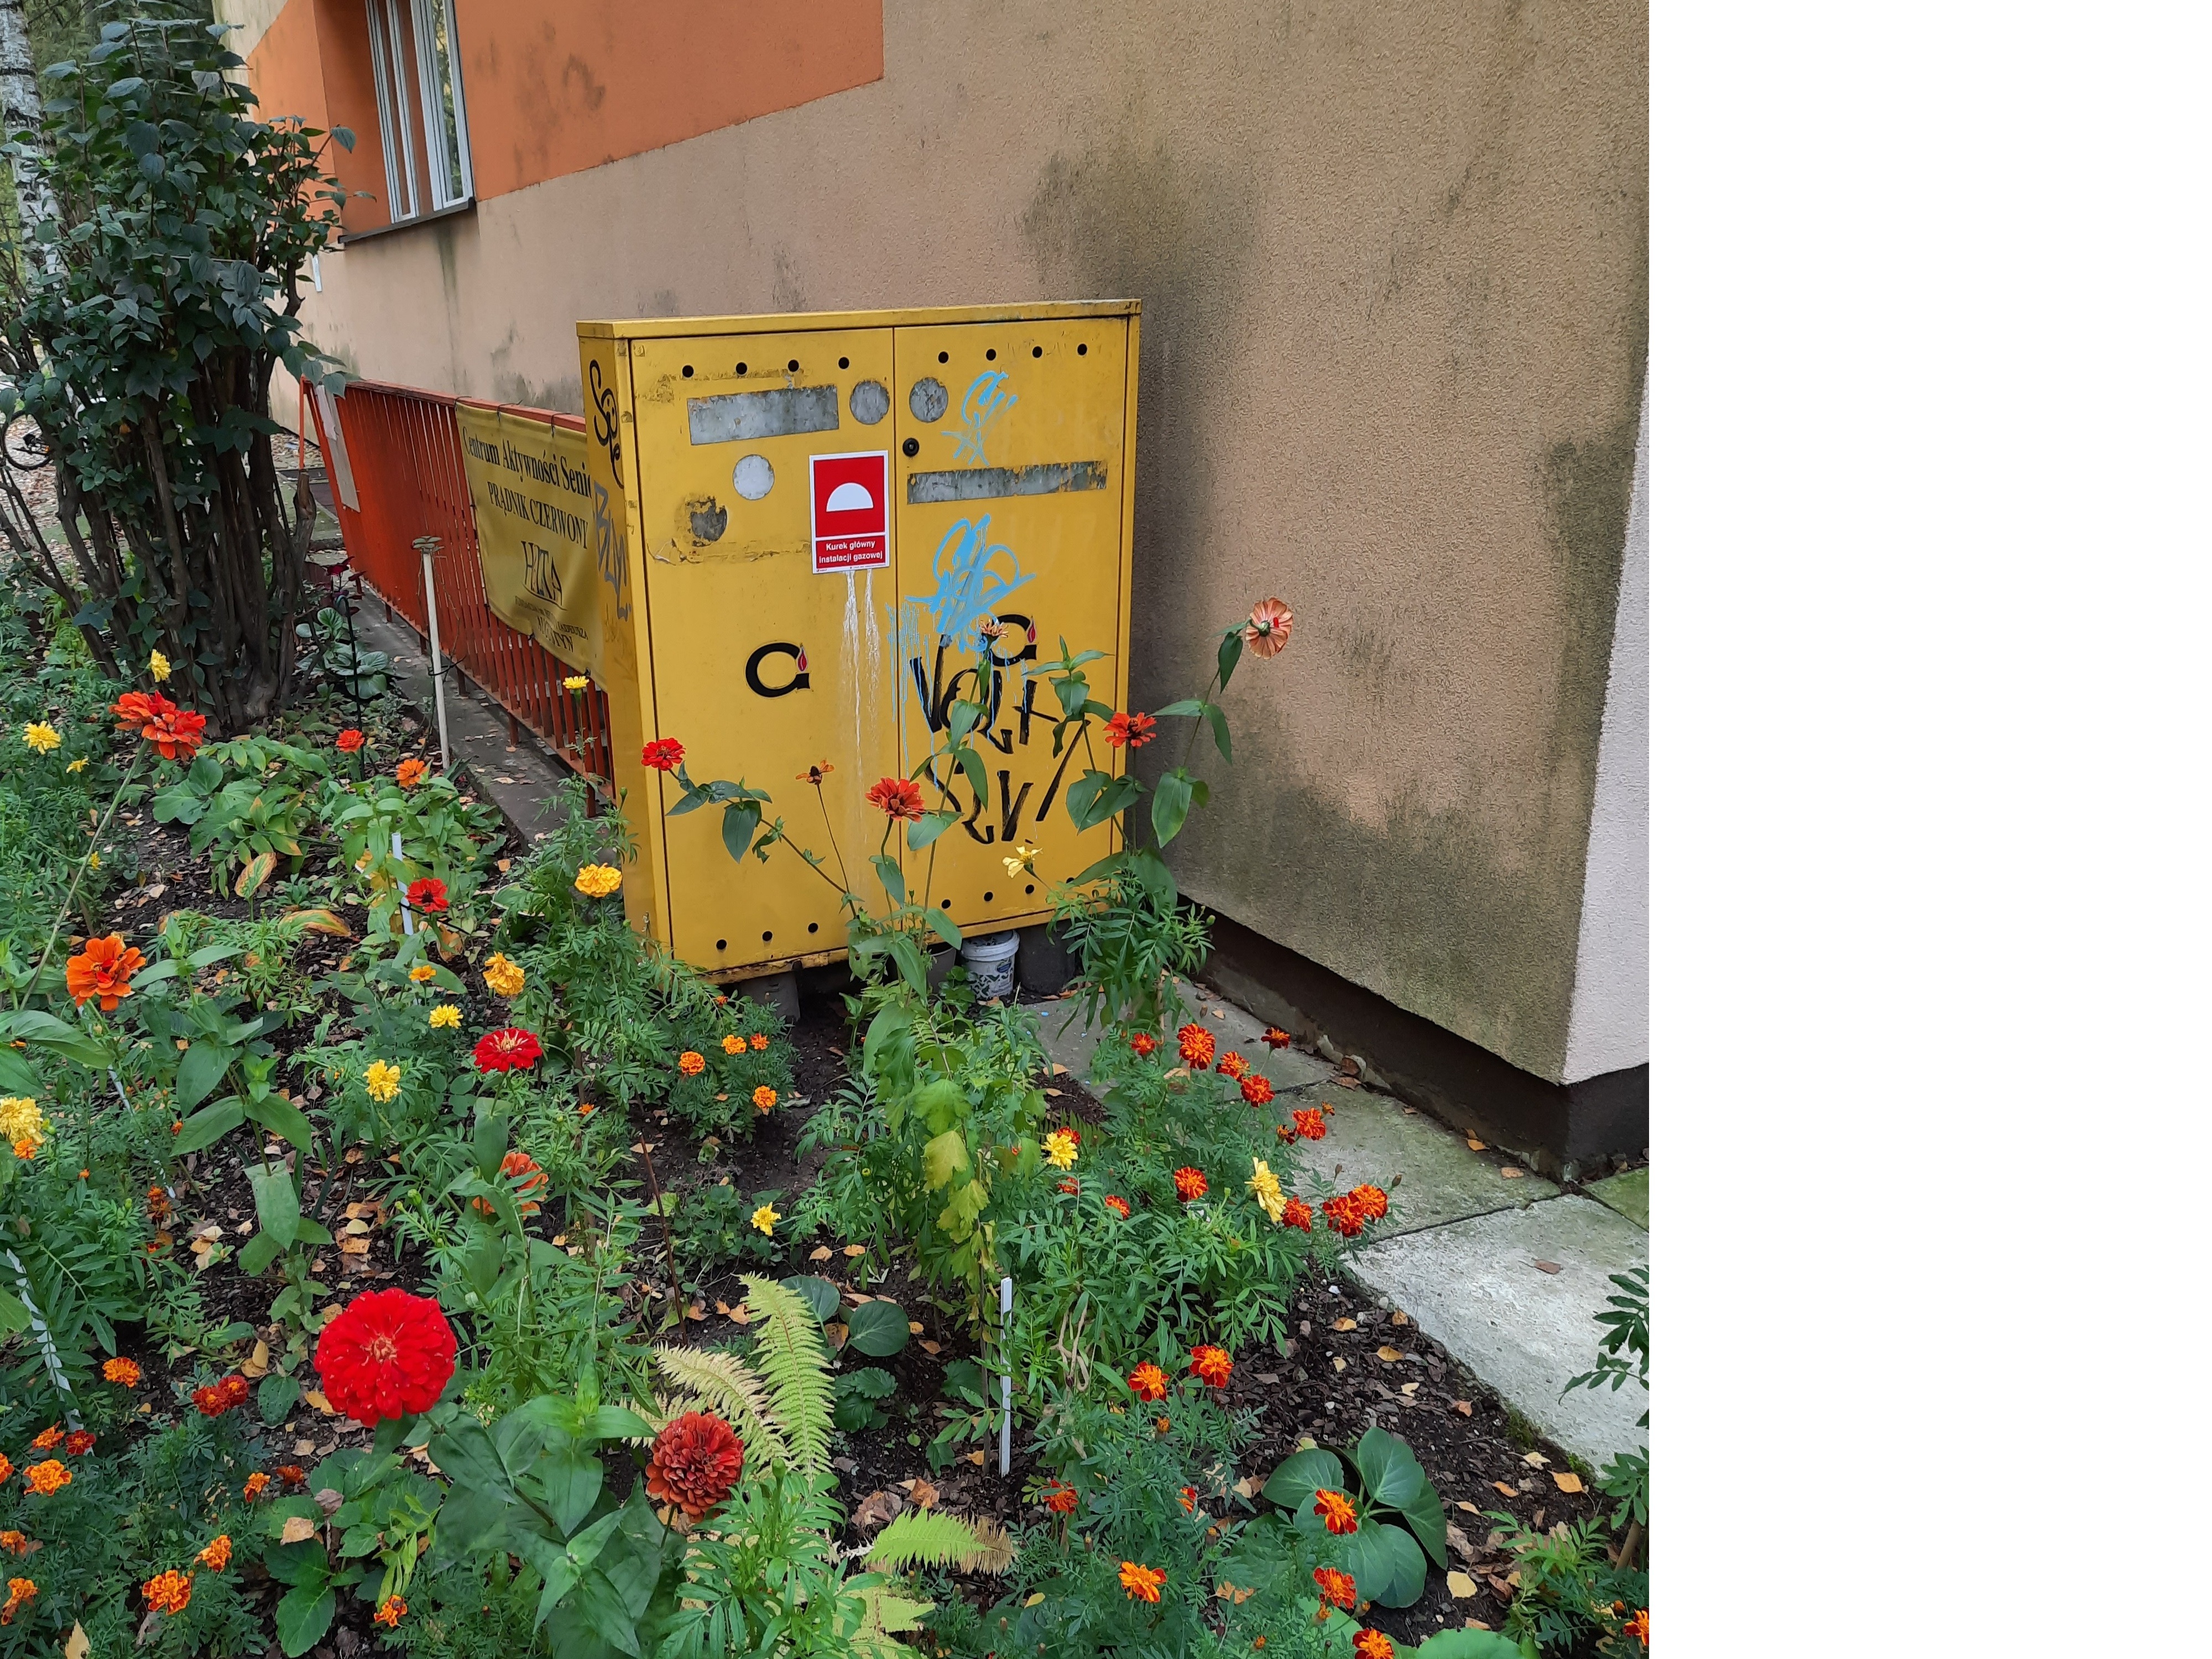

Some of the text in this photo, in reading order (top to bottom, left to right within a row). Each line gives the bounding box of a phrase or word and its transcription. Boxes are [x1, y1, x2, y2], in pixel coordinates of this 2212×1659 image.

[463, 426, 500, 466] Centrum
[502, 439, 560, 487] Aktywności
[487, 481, 588, 549] PRĄDNIK CZERWONY
[819, 551, 883, 564] instalacji gazowej
[826, 541, 875, 551] Kurek główny
